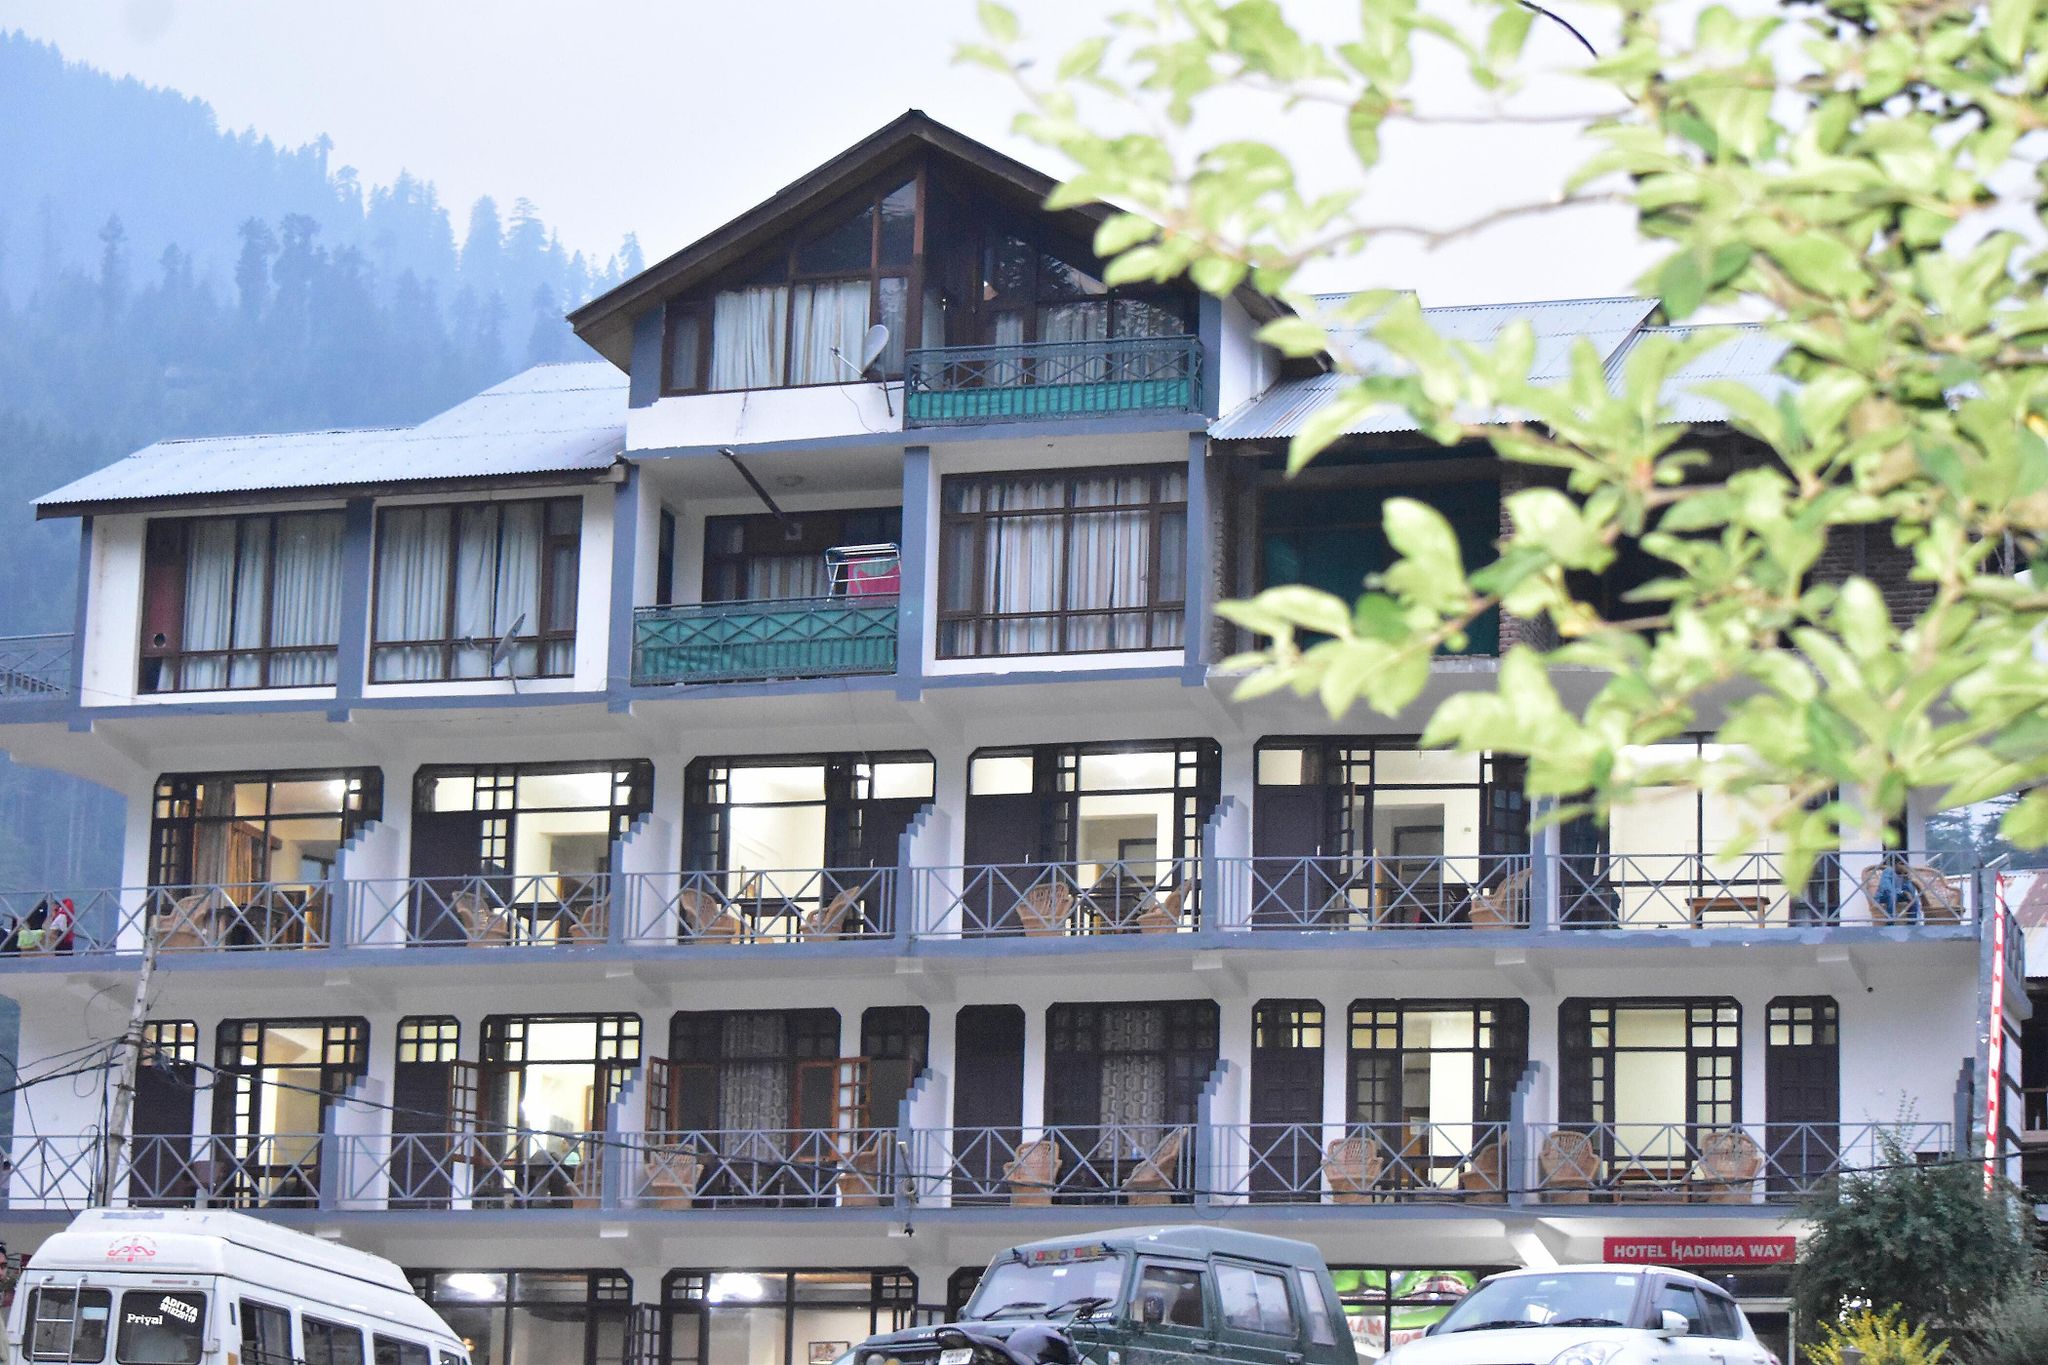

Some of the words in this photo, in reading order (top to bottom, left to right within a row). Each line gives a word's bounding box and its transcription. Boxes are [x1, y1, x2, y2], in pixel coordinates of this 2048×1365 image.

[1613, 1244, 1666, 1258] HOTEL
[1671, 1240, 1745, 1261] HADIMBA
[1749, 1244, 1784, 1258] WAY
[162, 1295, 198, 1317] ADITYA
[126, 1313, 163, 1326] Priyal
